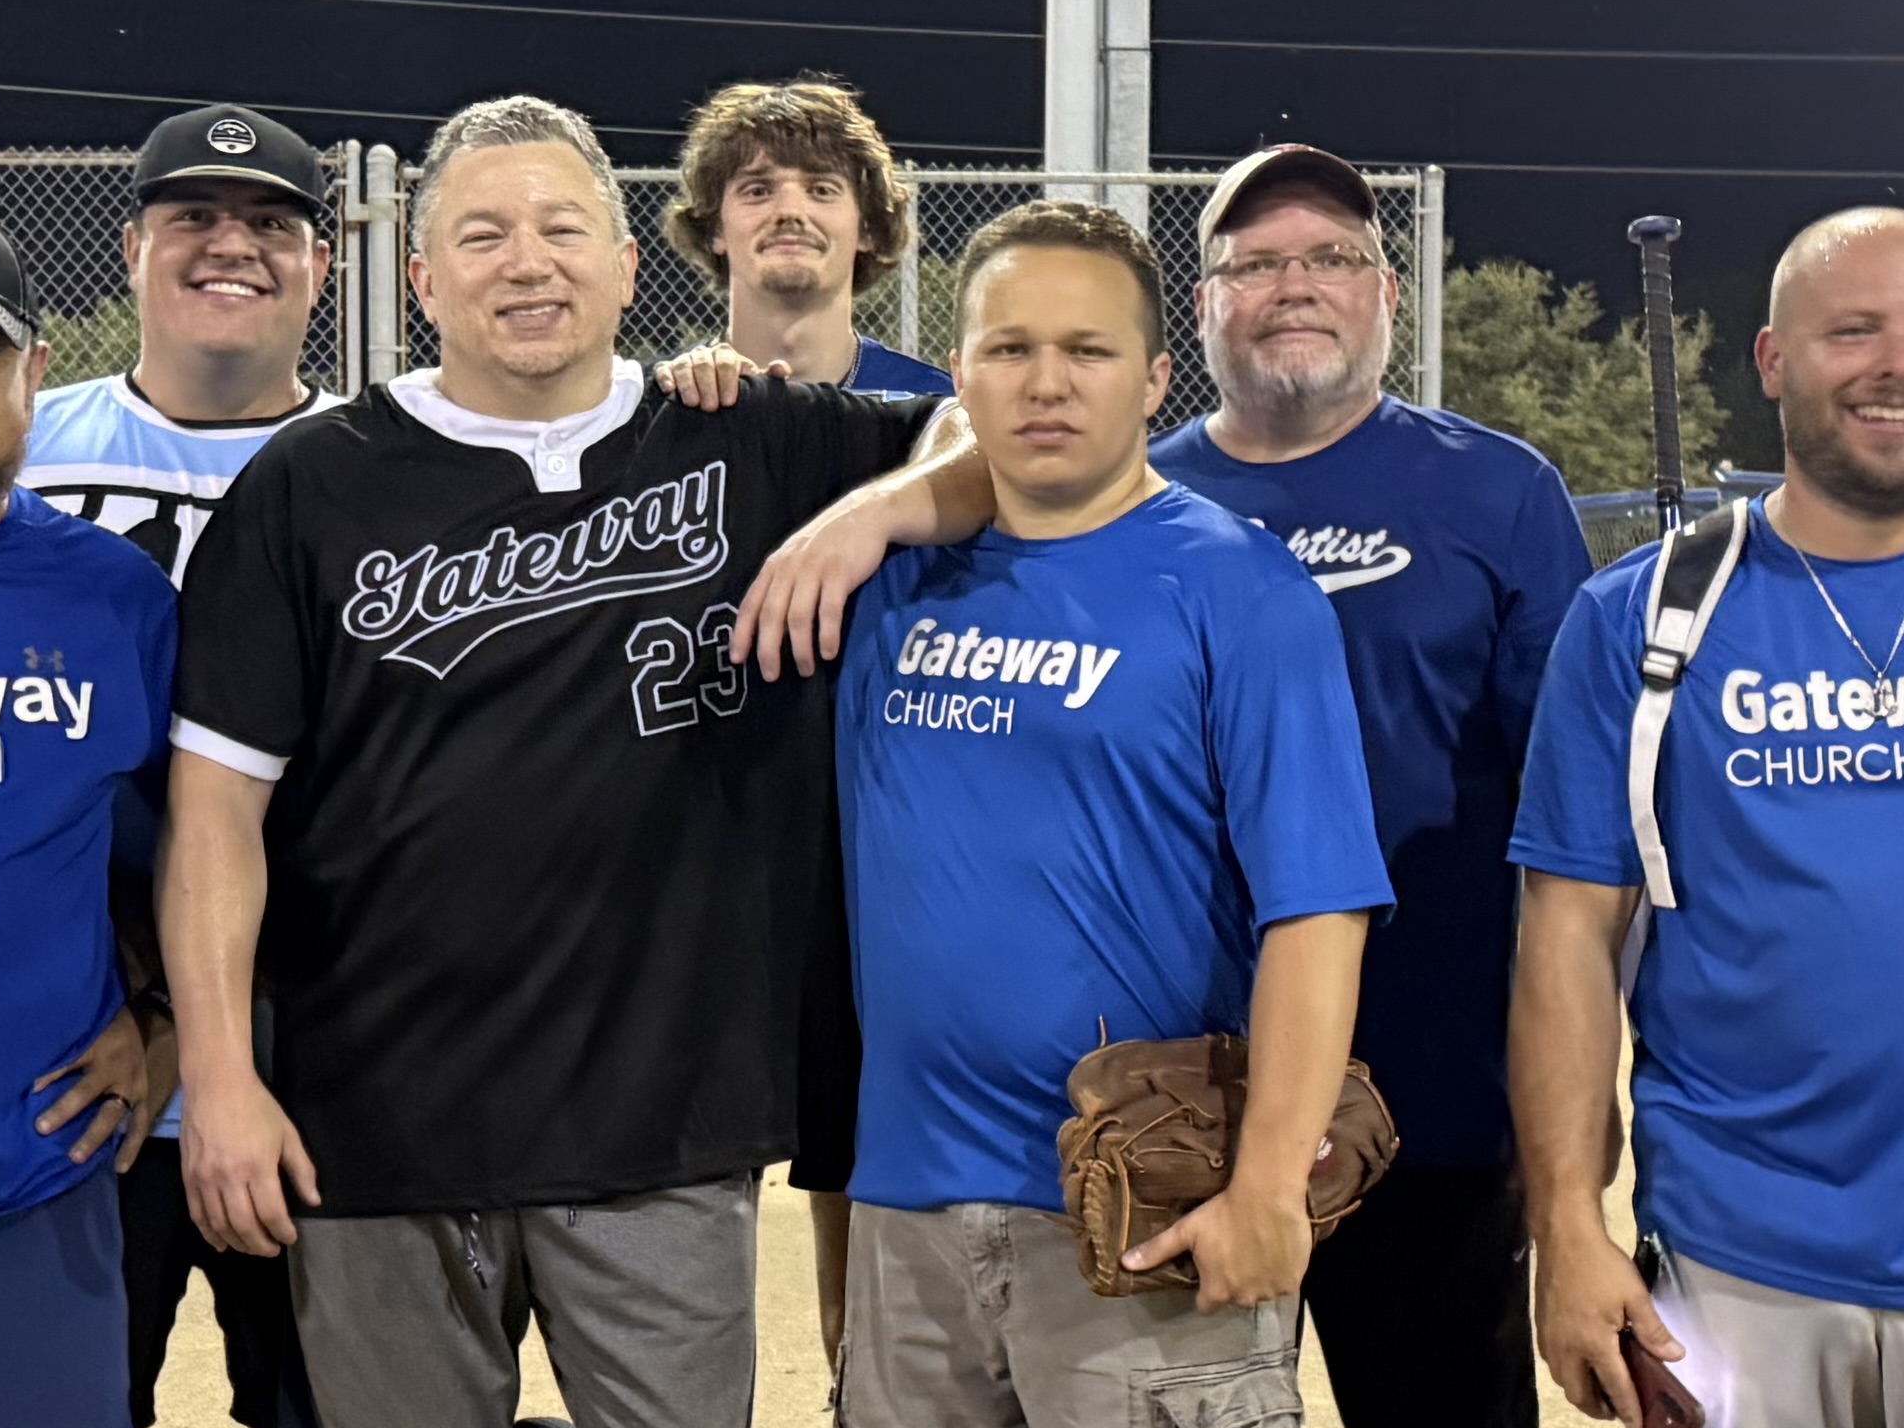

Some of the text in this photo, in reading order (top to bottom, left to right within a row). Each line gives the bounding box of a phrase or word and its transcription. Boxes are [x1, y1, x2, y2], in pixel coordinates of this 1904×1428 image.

[342, 460, 729, 640] Gateway
[625, 602, 748, 736] 23
[884, 689, 1015, 735] CHURCH
[897, 618, 1121, 709] Gateway
